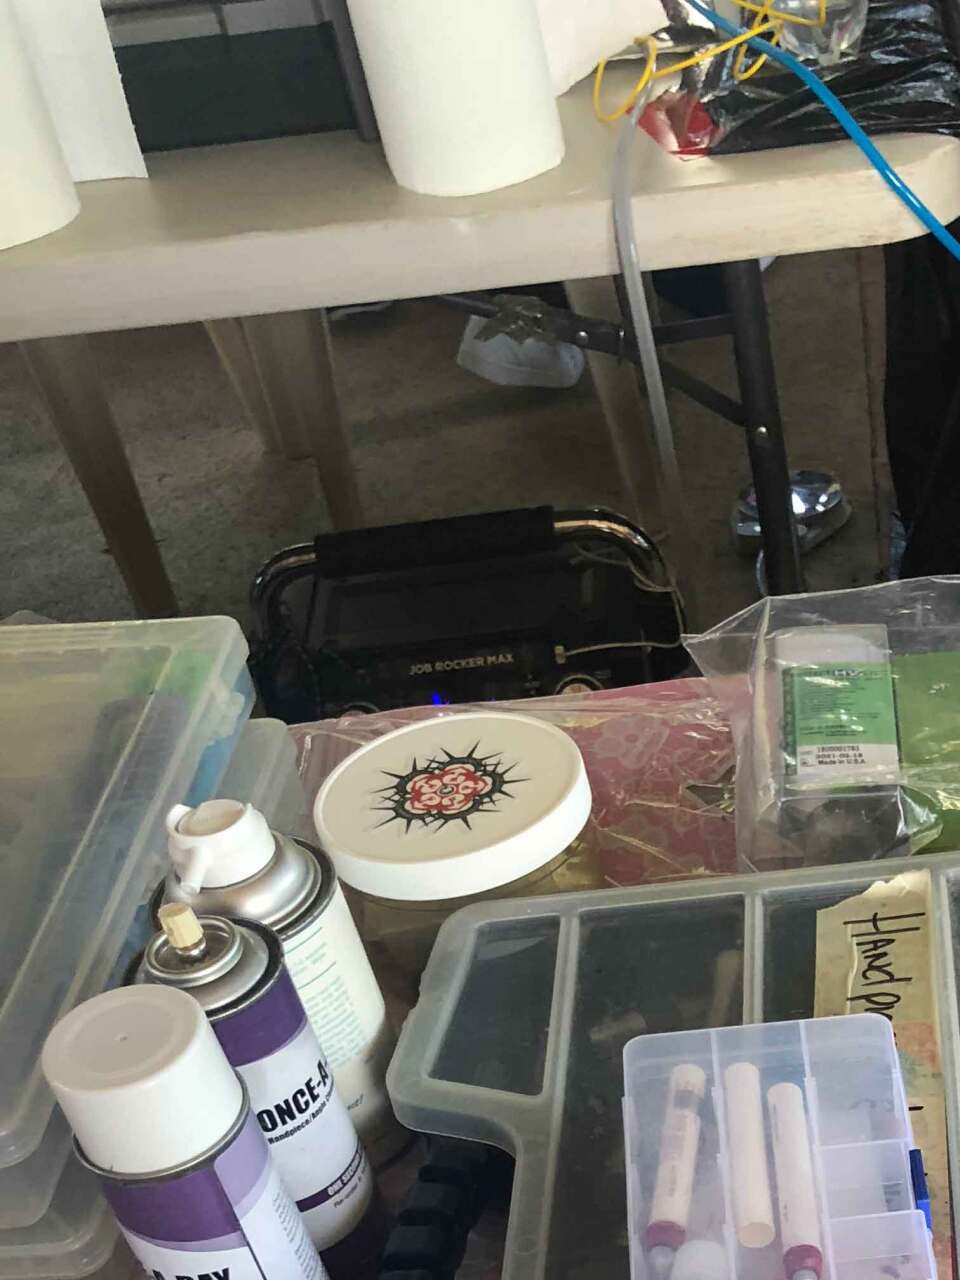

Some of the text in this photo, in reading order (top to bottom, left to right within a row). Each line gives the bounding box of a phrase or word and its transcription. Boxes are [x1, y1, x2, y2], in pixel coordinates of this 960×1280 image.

[409, 654, 514, 676] JOB ROCKER MAX
